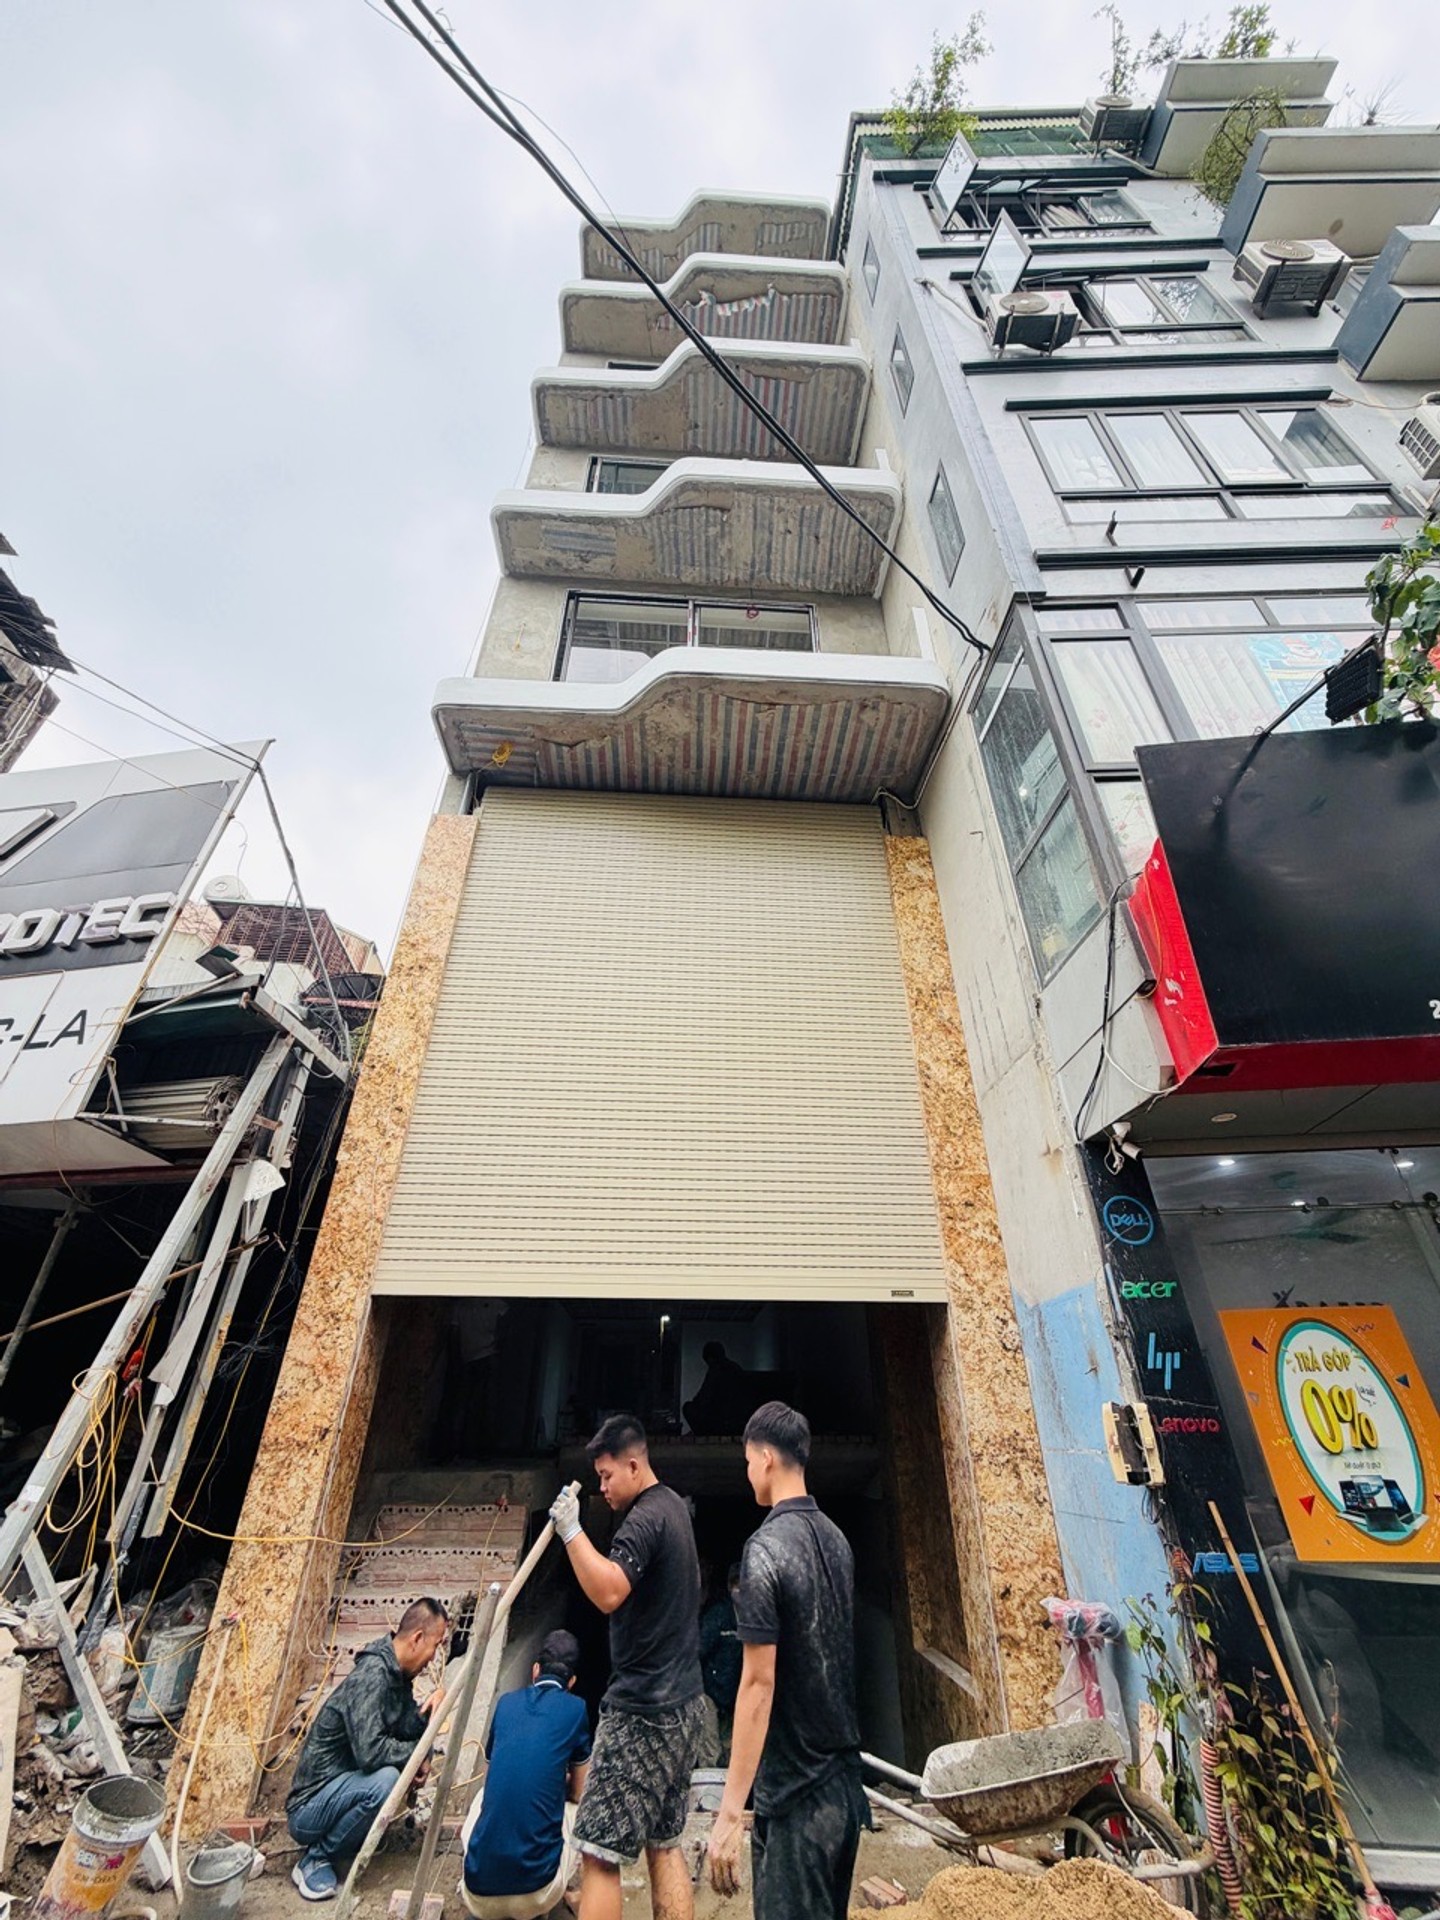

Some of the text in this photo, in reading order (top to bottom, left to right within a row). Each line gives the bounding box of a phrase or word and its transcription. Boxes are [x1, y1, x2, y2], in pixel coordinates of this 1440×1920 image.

[0, 892, 178, 953] OTEC
[1110, 1213, 1148, 1227] DELL
[1121, 1281, 1177, 1299] acer
[1147, 1332, 1181, 1390] hp
[1301, 1379, 1378, 1455] 0%
